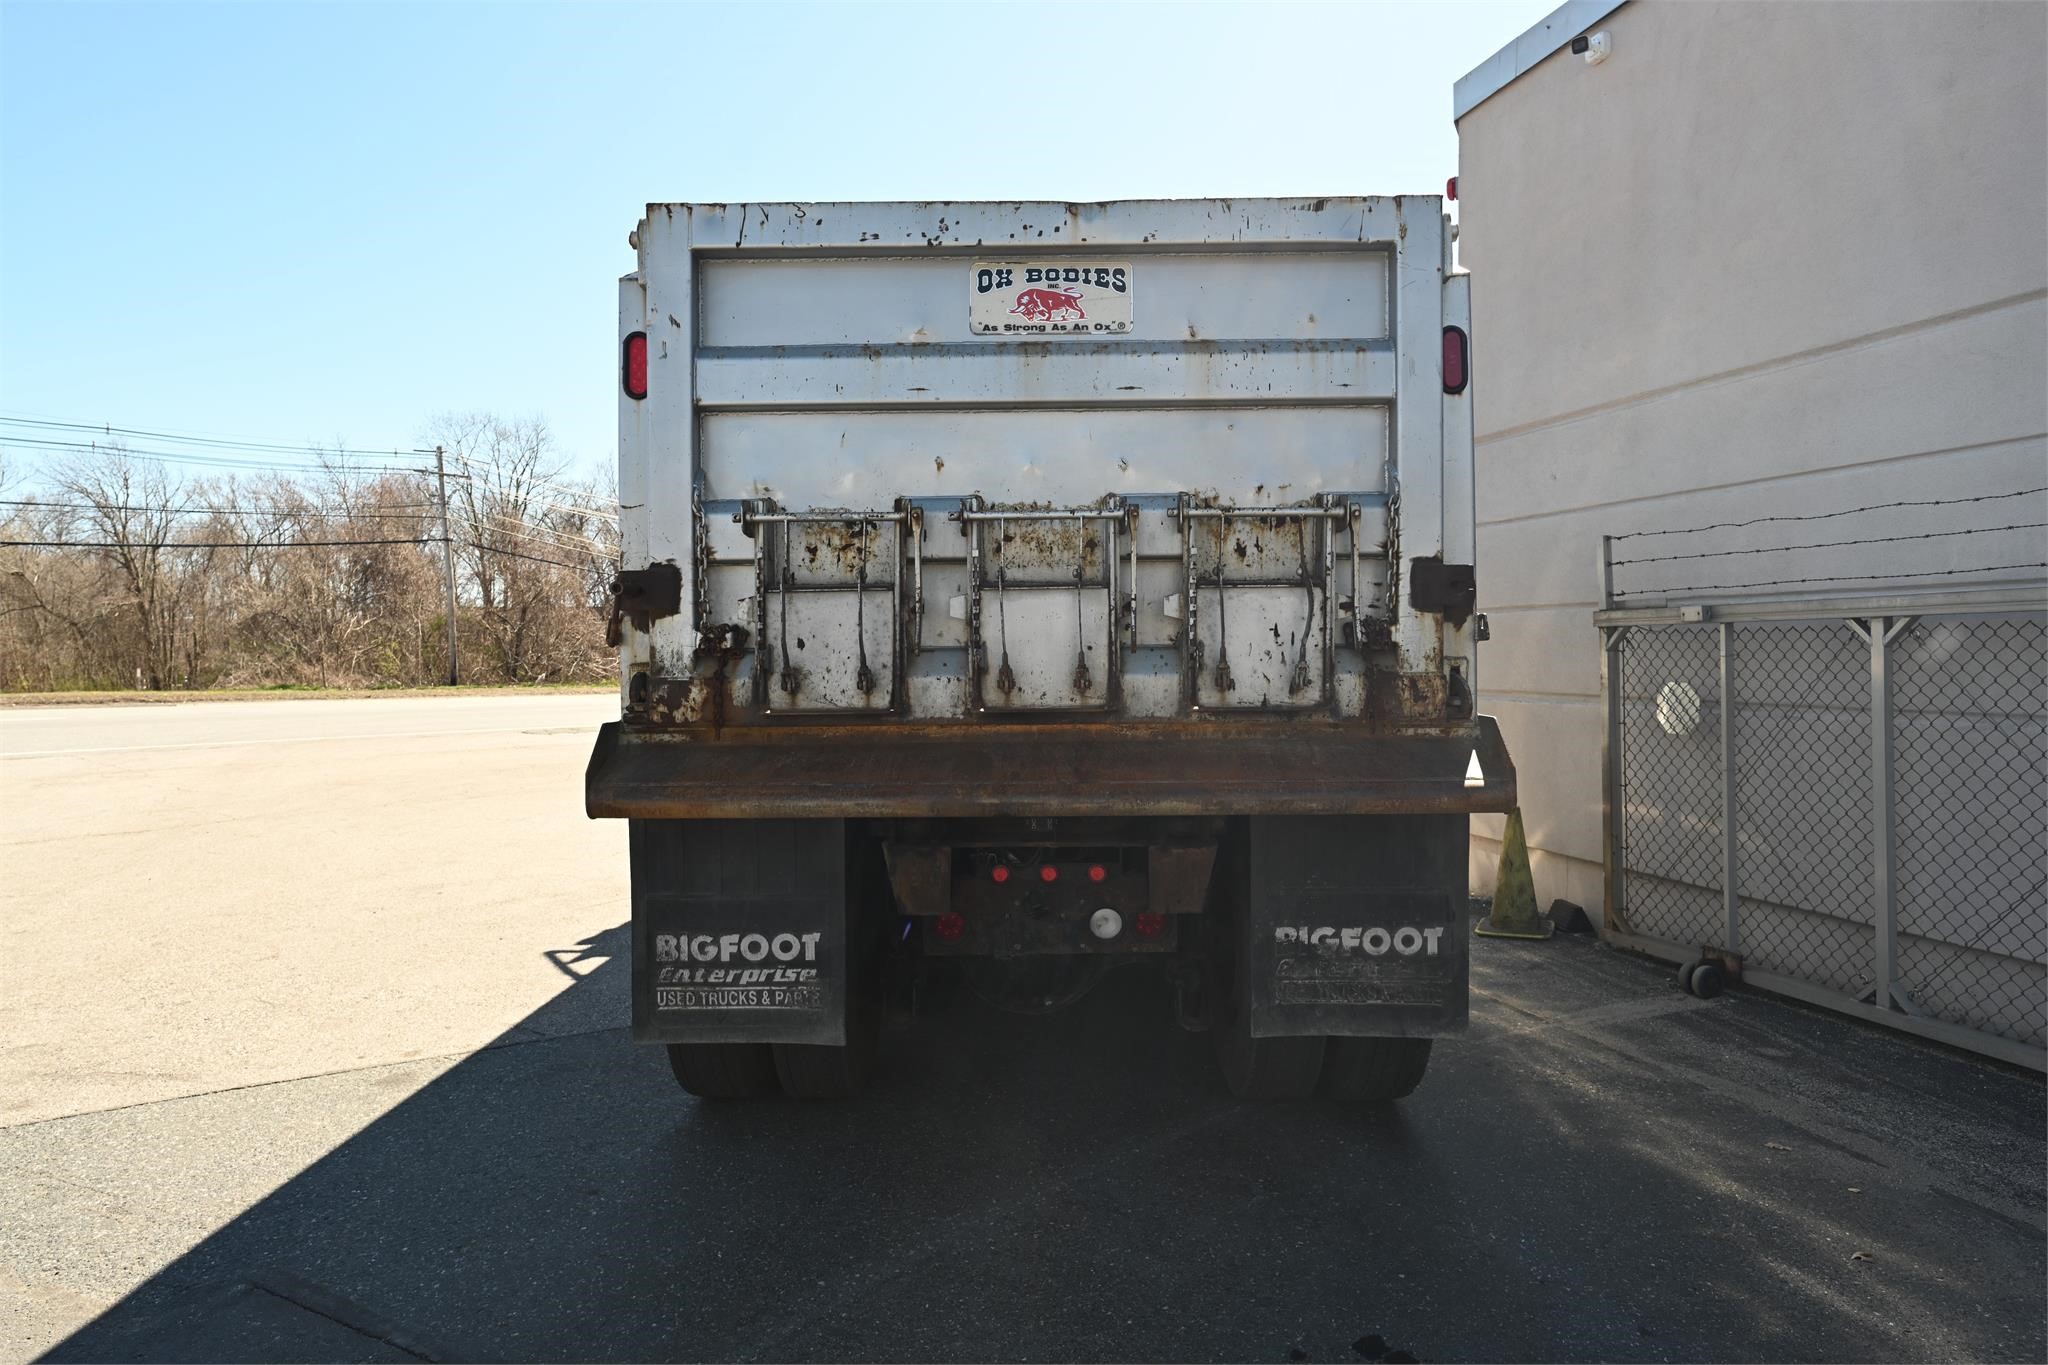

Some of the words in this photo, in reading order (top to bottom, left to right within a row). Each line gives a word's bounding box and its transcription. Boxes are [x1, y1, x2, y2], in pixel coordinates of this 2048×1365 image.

[977, 268, 1013, 294] OX
[1025, 268, 1127, 293] BODIES
[1004, 324, 1045, 332] Strong
[1073, 323, 1088, 331] An
[656, 933, 821, 962] BIGFOOT
[1275, 926, 1444, 956] BIGFOOT
[657, 991, 695, 1006] USED
[700, 991, 757, 1005] TRUCKS
[762, 991, 770, 1005] &
